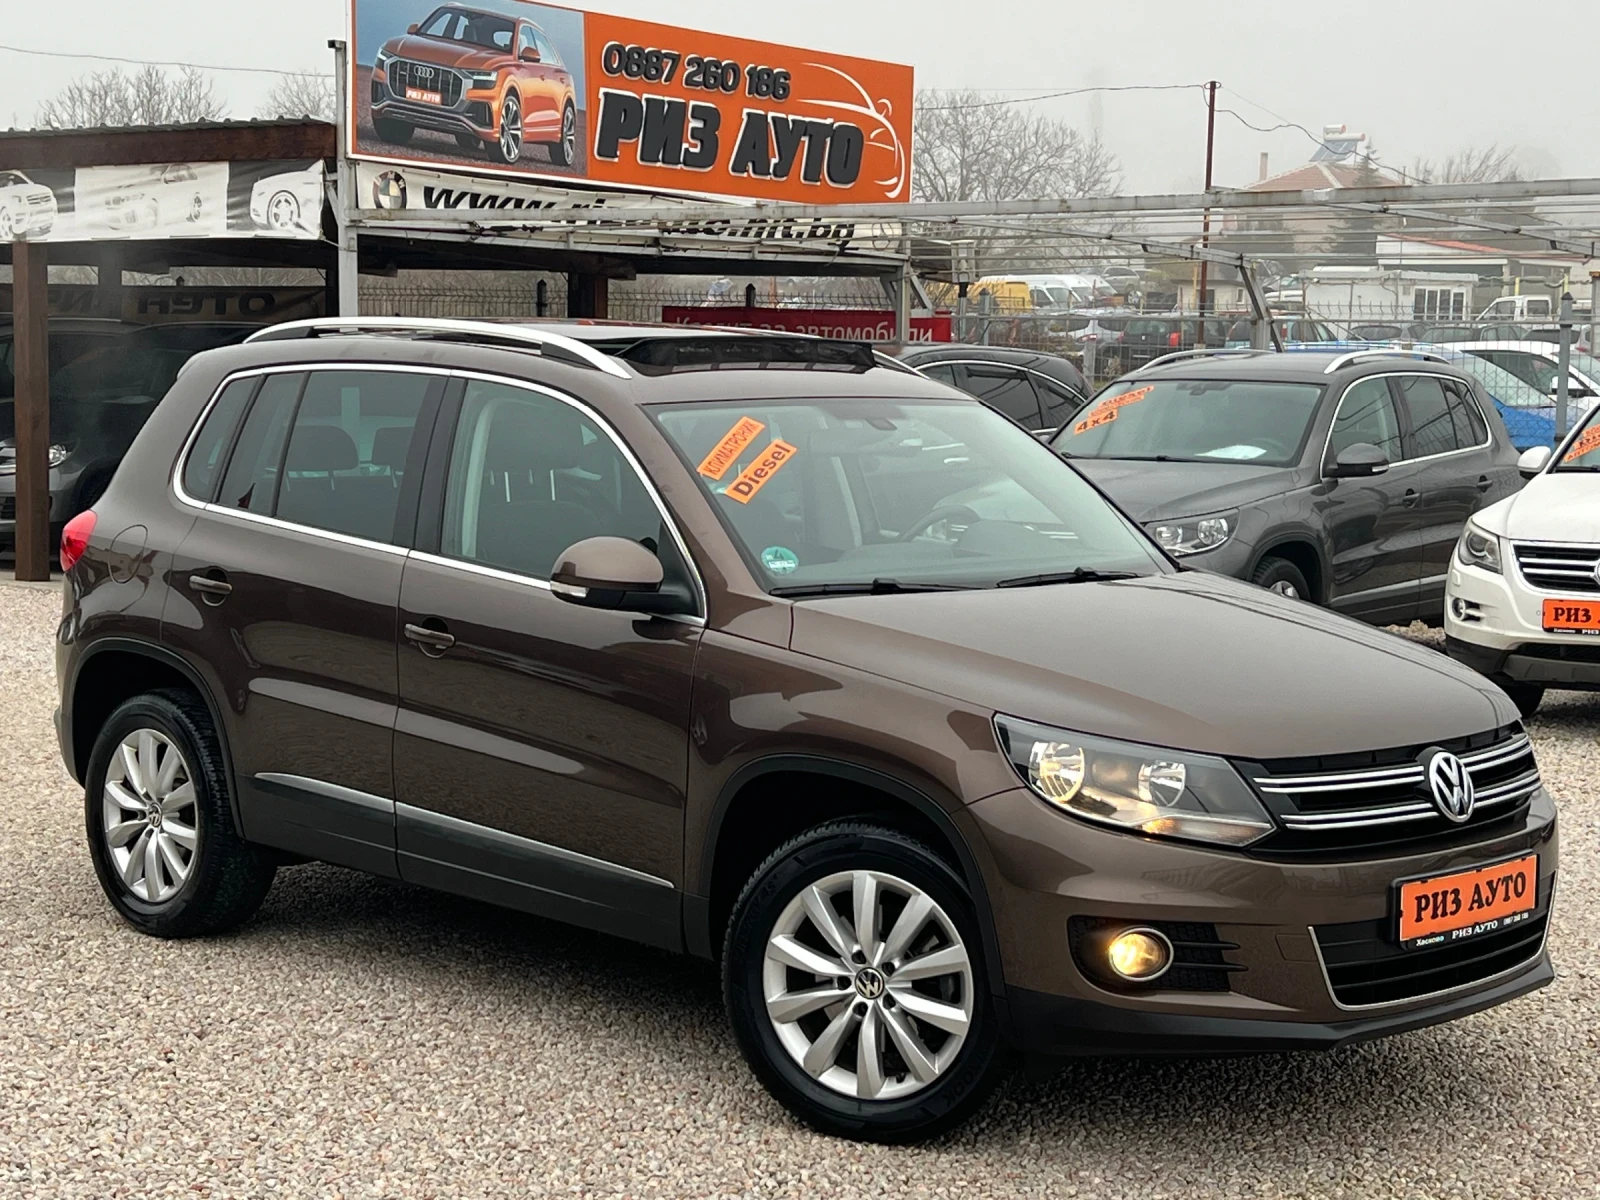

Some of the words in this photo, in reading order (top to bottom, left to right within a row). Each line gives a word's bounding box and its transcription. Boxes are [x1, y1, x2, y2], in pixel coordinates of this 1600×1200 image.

[602, 41, 681, 85] 0887
[682, 54, 741, 94] 260
[745, 64, 792, 101] 186
[594, 87, 721, 172] РИЗ
[728, 108, 865, 187] АУТО
[733, 443, 791, 497] Diesel
[1553, 607, 1592, 623] РИЗ
[1415, 887, 1462, 922] РИЗ
[1468, 871, 1526, 911] АУТО
